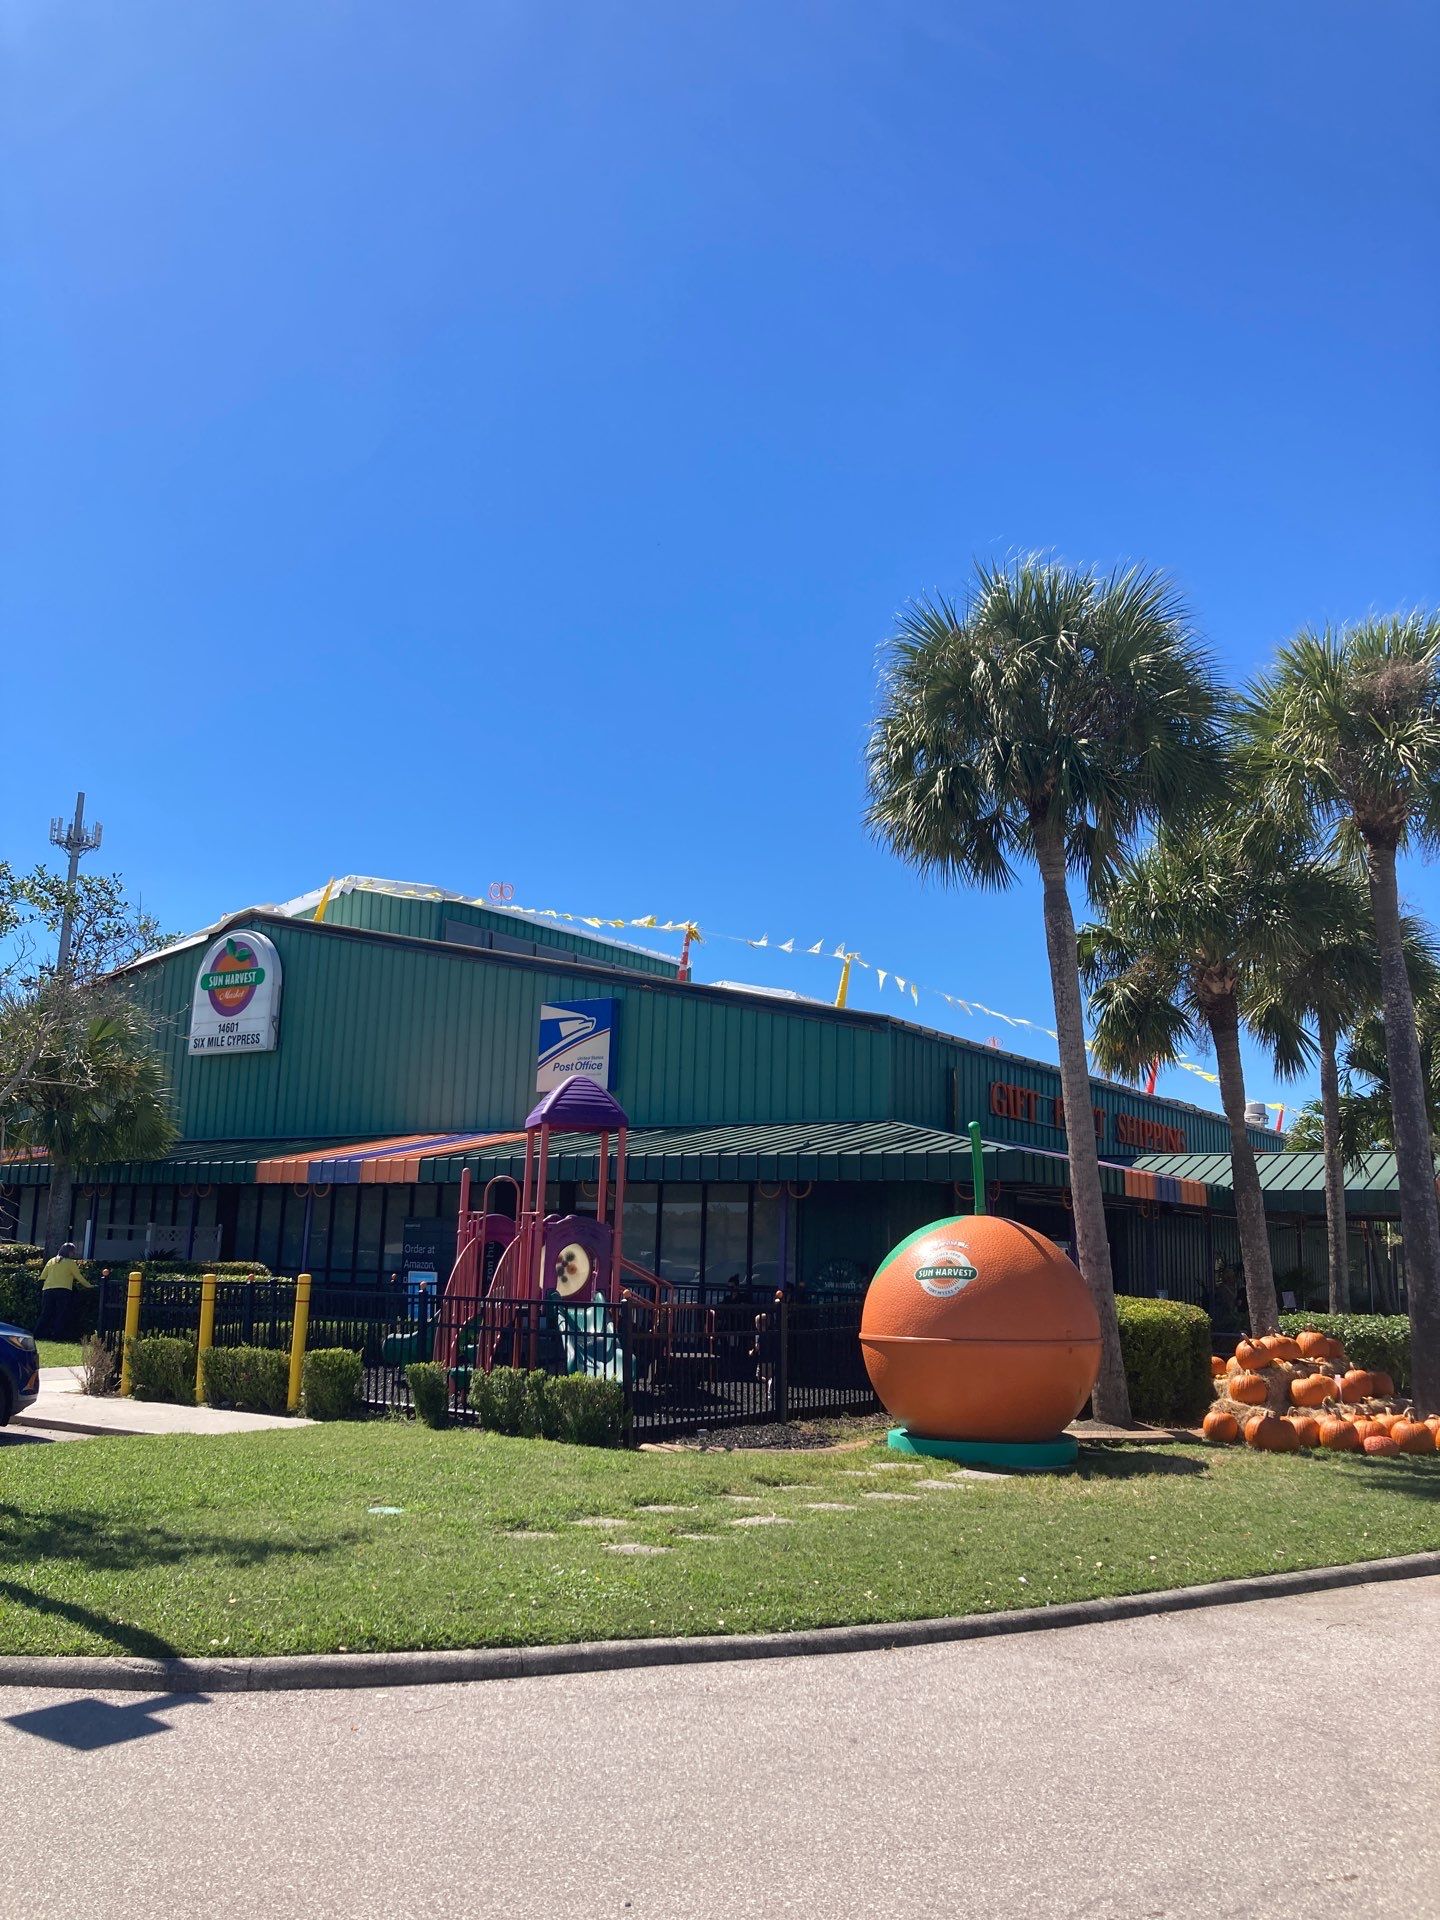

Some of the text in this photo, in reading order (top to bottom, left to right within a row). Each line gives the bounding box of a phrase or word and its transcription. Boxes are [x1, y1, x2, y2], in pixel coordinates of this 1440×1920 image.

[208, 971, 257, 987] SUN HARVEST
[218, 1022, 239, 1034] 14601
[193, 1033, 261, 1049] SIX MILE CYPRESS
[552, 1061, 603, 1072] Post Office
[990, 1081, 1041, 1124] GIFT
[1115, 1112, 1186, 1154] SHIPPING
[404, 1244, 436, 1254] Order at
[403, 1260, 435, 1271] Amazon,
[918, 1268, 974, 1278] SUN HARVEST
